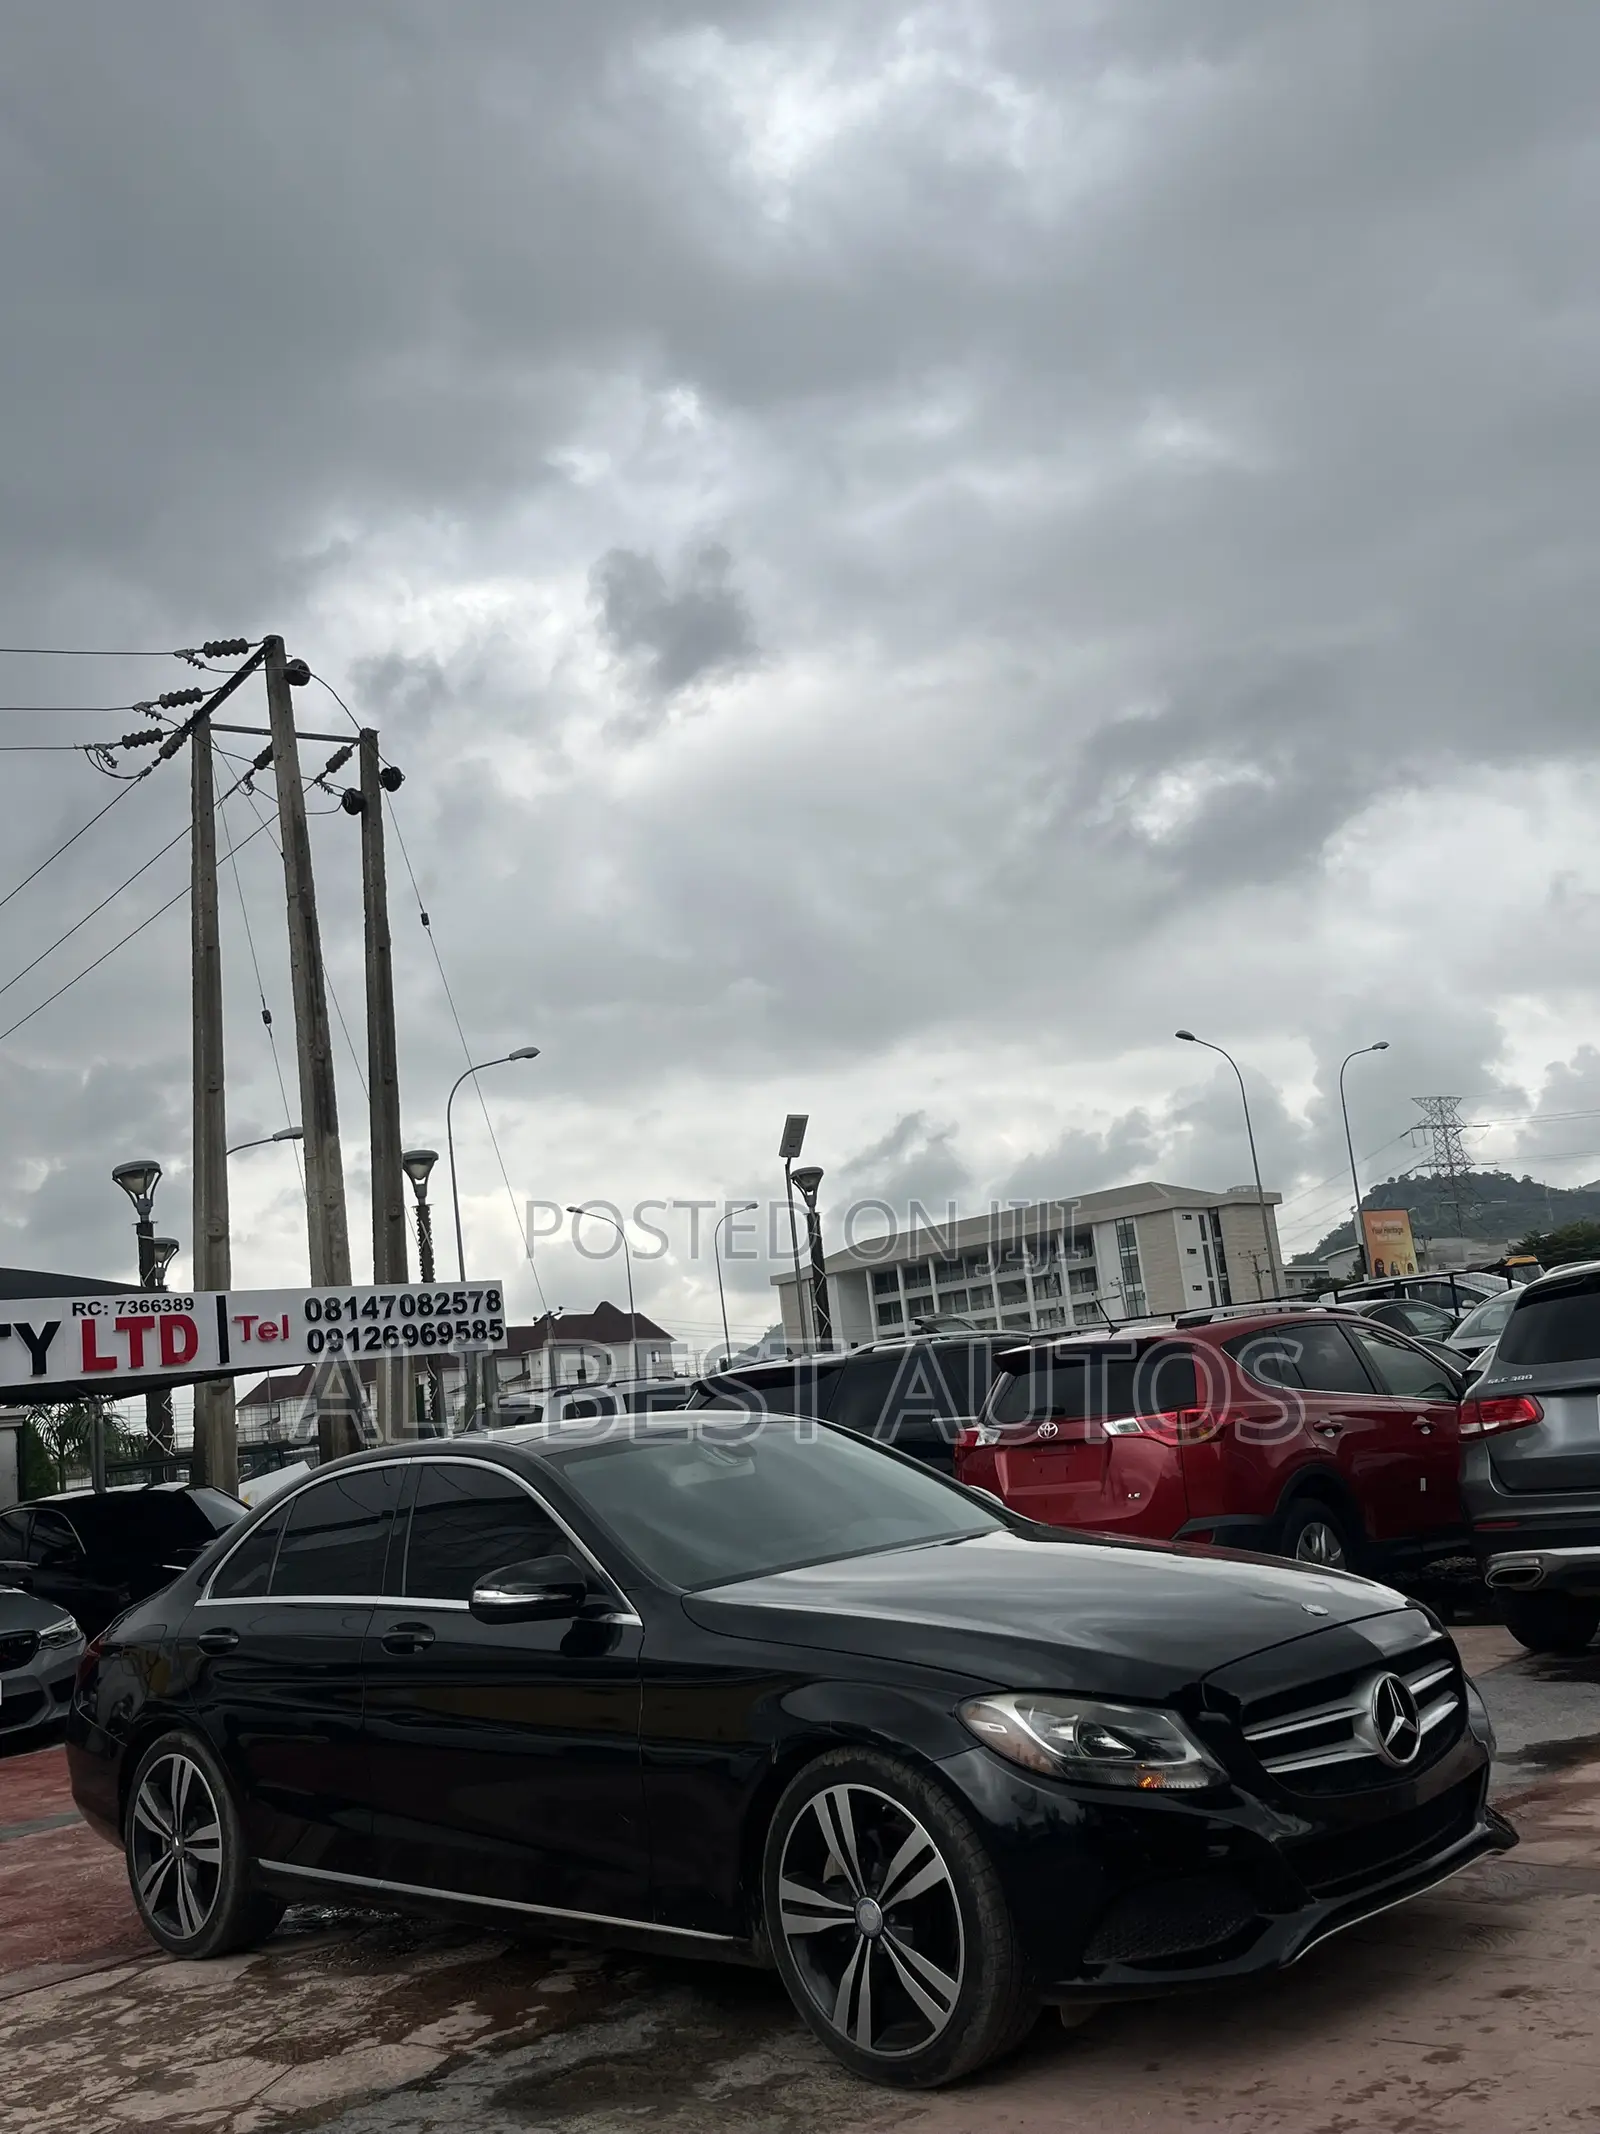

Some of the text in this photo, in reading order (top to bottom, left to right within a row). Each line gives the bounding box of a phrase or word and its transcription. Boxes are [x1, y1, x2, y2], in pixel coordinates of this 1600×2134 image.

[72, 1297, 195, 1317] RC: 7366389
[304, 1289, 502, 1322] 08147082578
[81, 1314, 199, 1372] LTD
[233, 1314, 290, 1342] Tel
[306, 1318, 505, 1353] 09126969585
